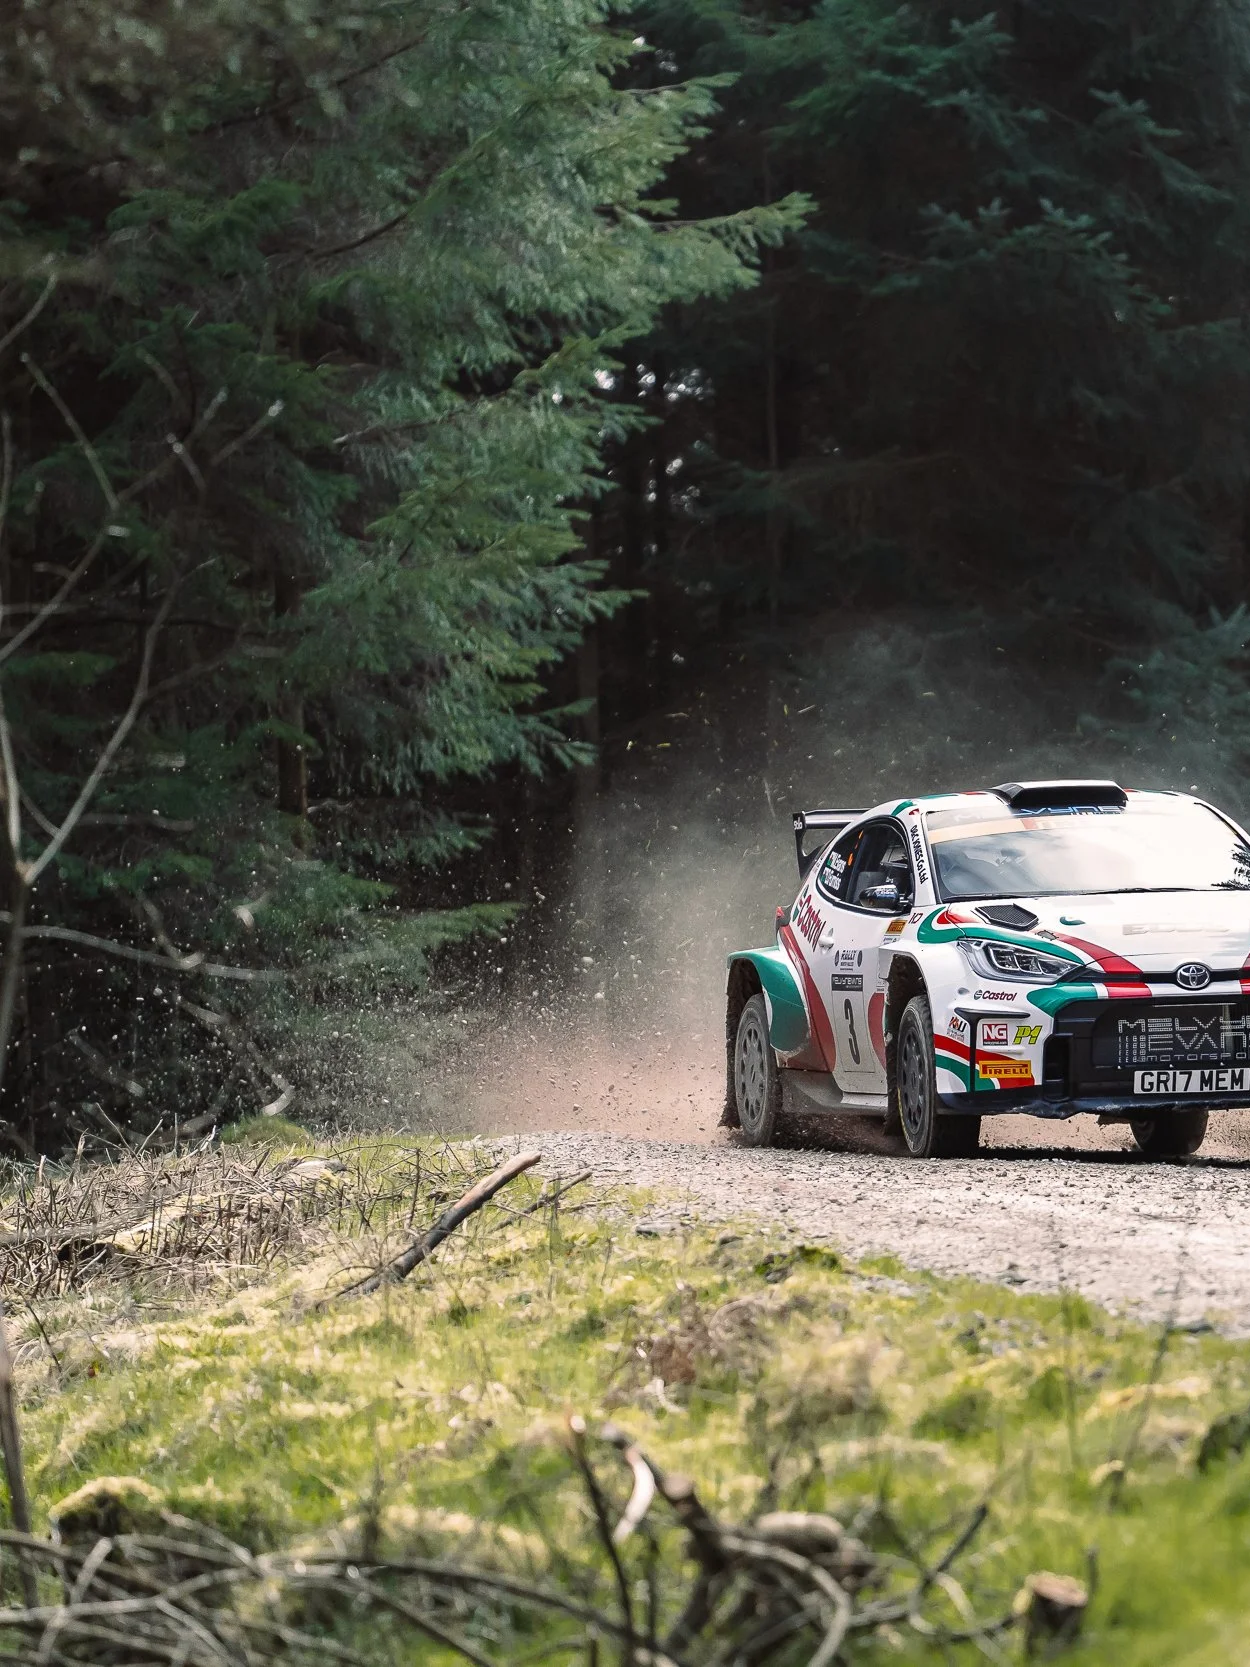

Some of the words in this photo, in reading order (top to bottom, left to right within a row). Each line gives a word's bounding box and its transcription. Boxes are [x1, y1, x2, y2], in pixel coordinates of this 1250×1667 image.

[913, 839, 923, 861] JONES
[919, 869, 928, 884] Ltd
[982, 990, 1018, 1002] Castrol
[983, 1024, 1007, 1040] NG
[1013, 1025, 1043, 1045] P1
[982, 1063, 1029, 1075] PIRELLI
[1141, 1071, 1194, 1092] GR17
[1199, 1069, 1245, 1091] MEM
